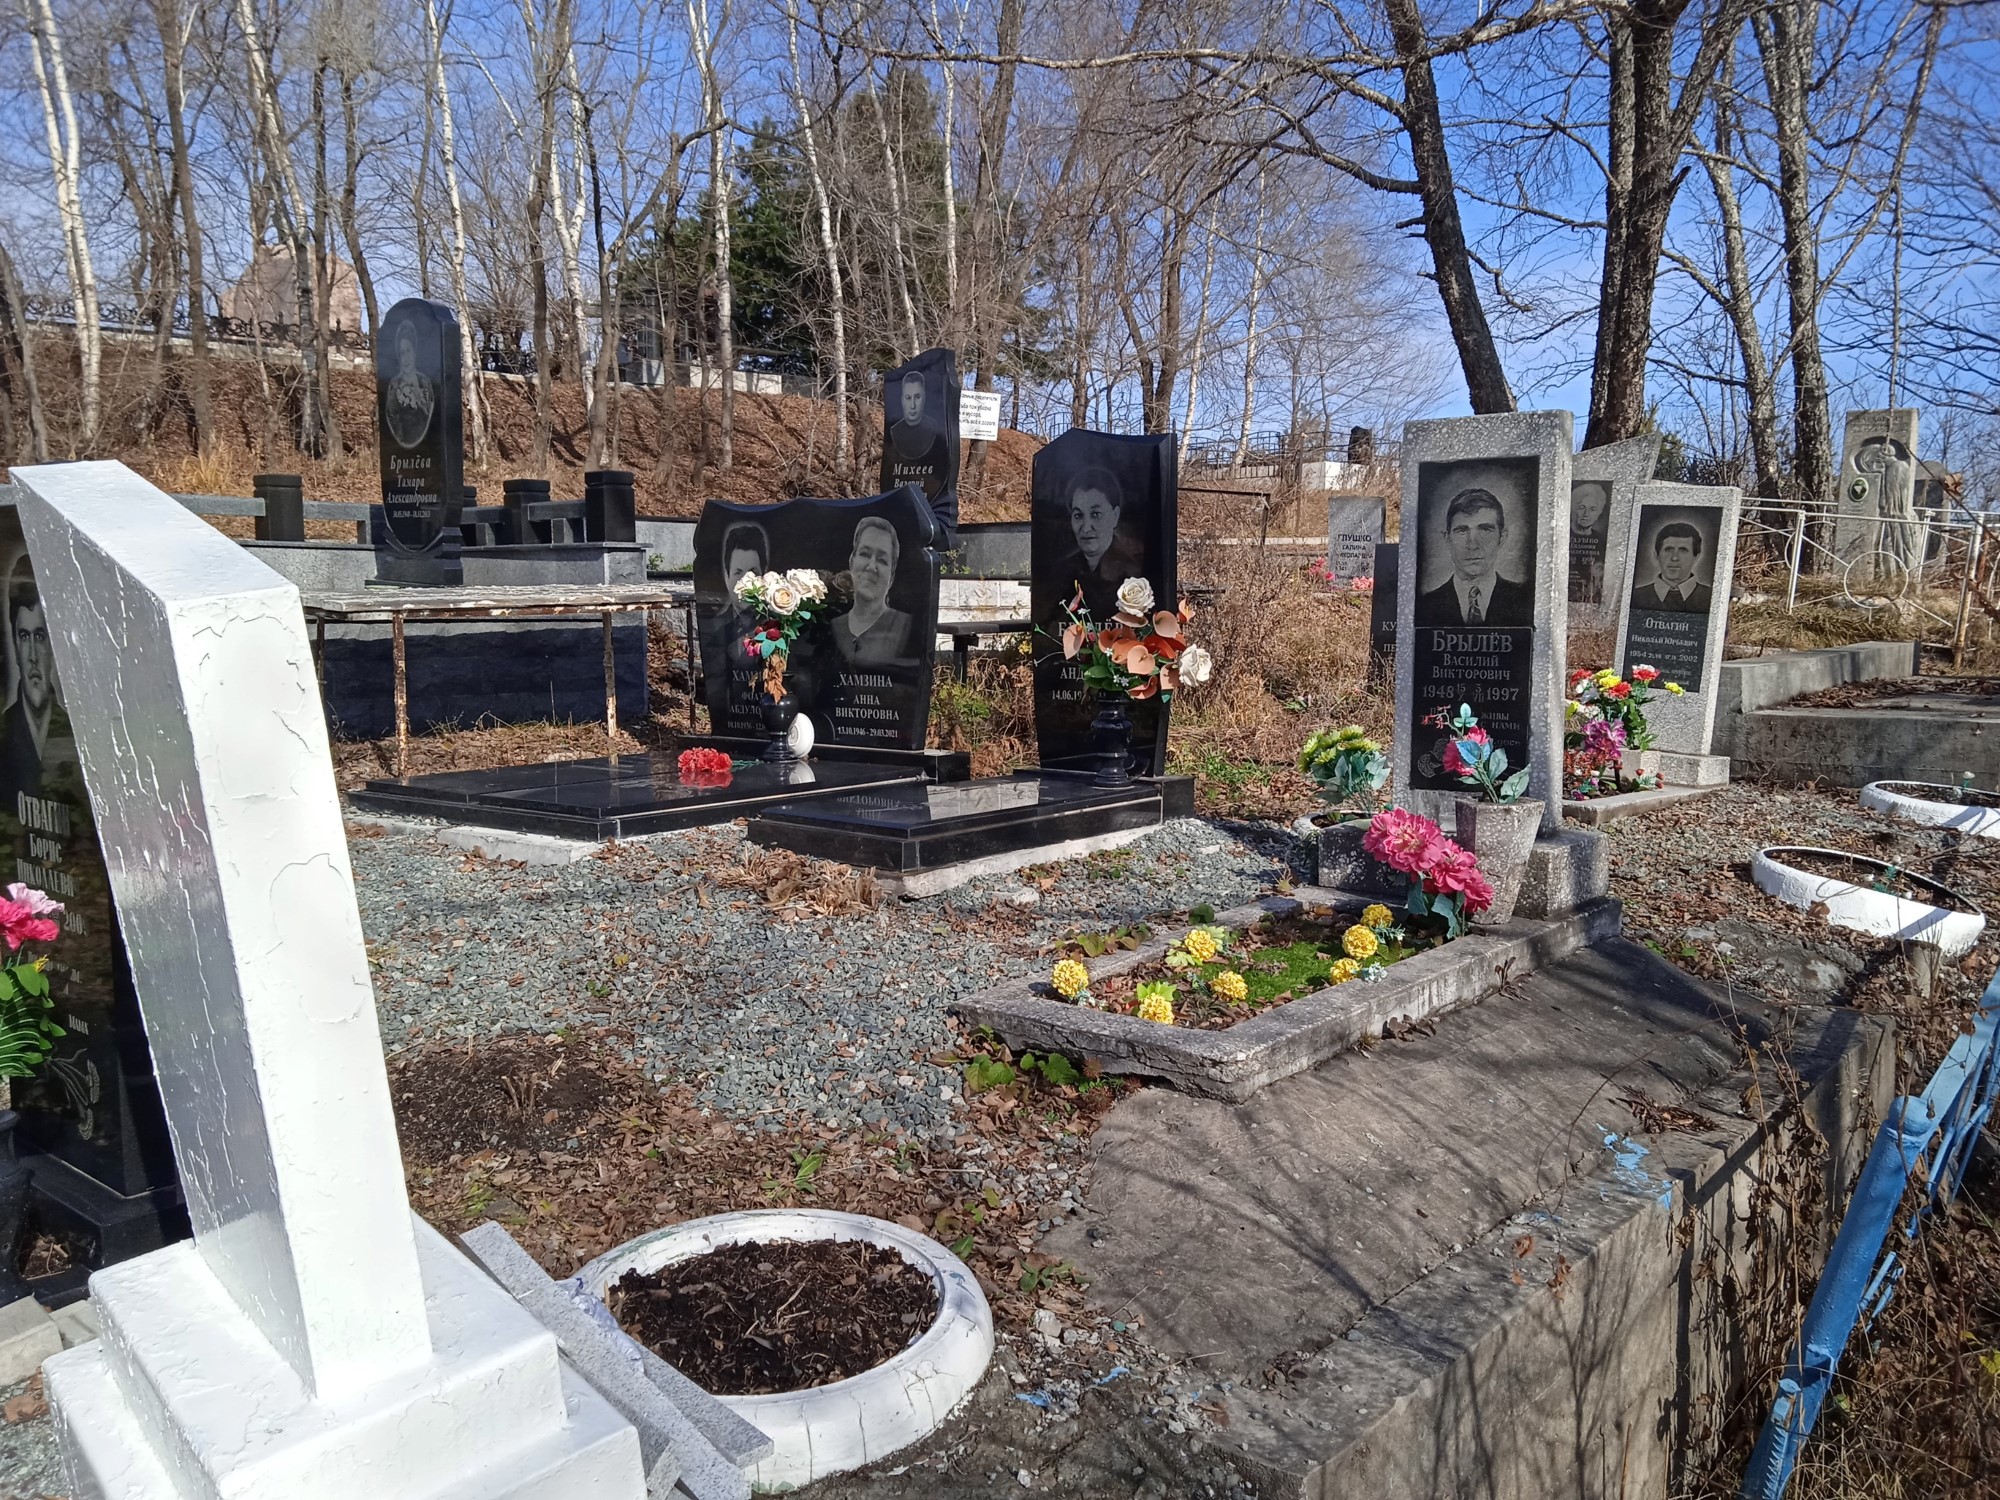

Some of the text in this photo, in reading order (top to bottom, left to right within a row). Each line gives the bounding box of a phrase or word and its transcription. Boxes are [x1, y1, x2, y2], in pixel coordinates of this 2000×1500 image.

[390, 455, 431, 474] Брылёва
[892, 463, 933, 475] Михеев
[397, 475, 425, 491] Тамара
[1337, 534, 1372, 542] ГЛУШКО
[1679, 654, 1699, 663] 2002
[840, 673, 893, 688] ХАМЗИНА
[853, 694, 880, 705] АННА
[1422, 684, 1454, 699] 1948
[1486, 687, 1520, 701] 1997
[835, 707, 899, 720] ВИКТОРОВНА
[29, 832, 62, 864] БОРИС
